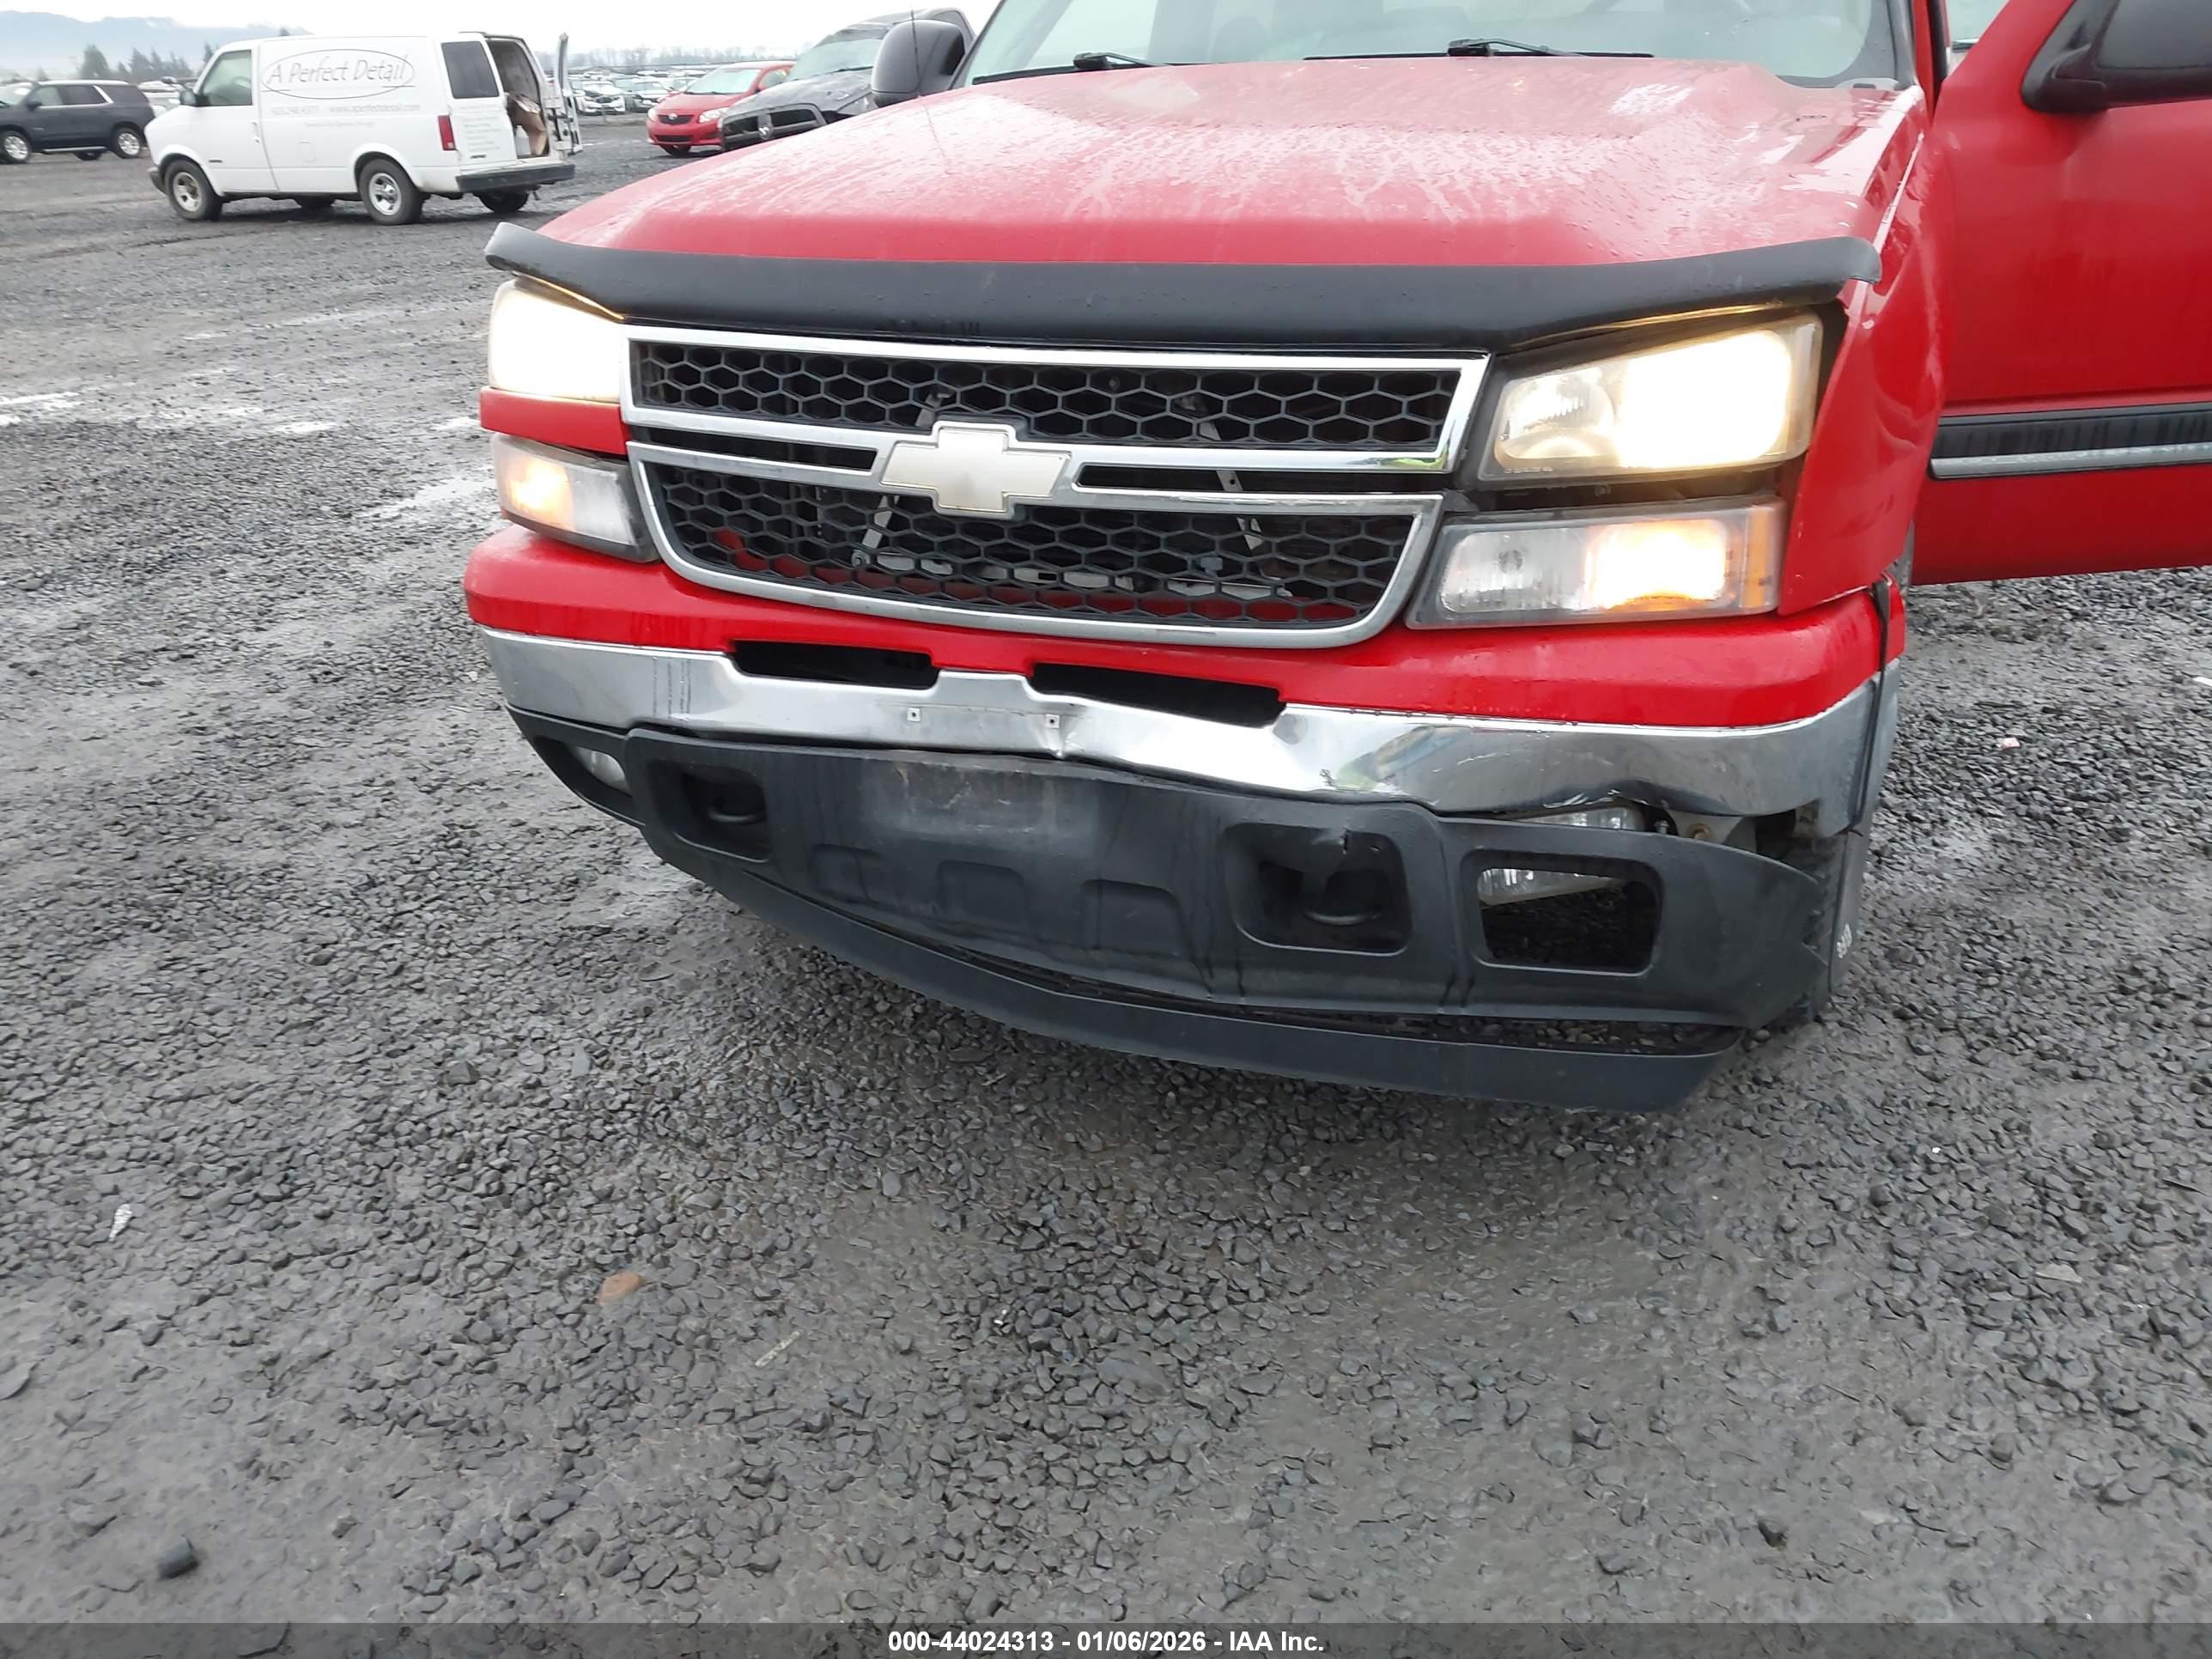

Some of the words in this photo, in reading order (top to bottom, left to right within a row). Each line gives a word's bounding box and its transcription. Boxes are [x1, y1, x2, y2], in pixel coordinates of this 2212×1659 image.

[266, 64, 283, 84] A
[289, 56, 349, 83] Perfect
[353, 54, 408, 82] Detail
